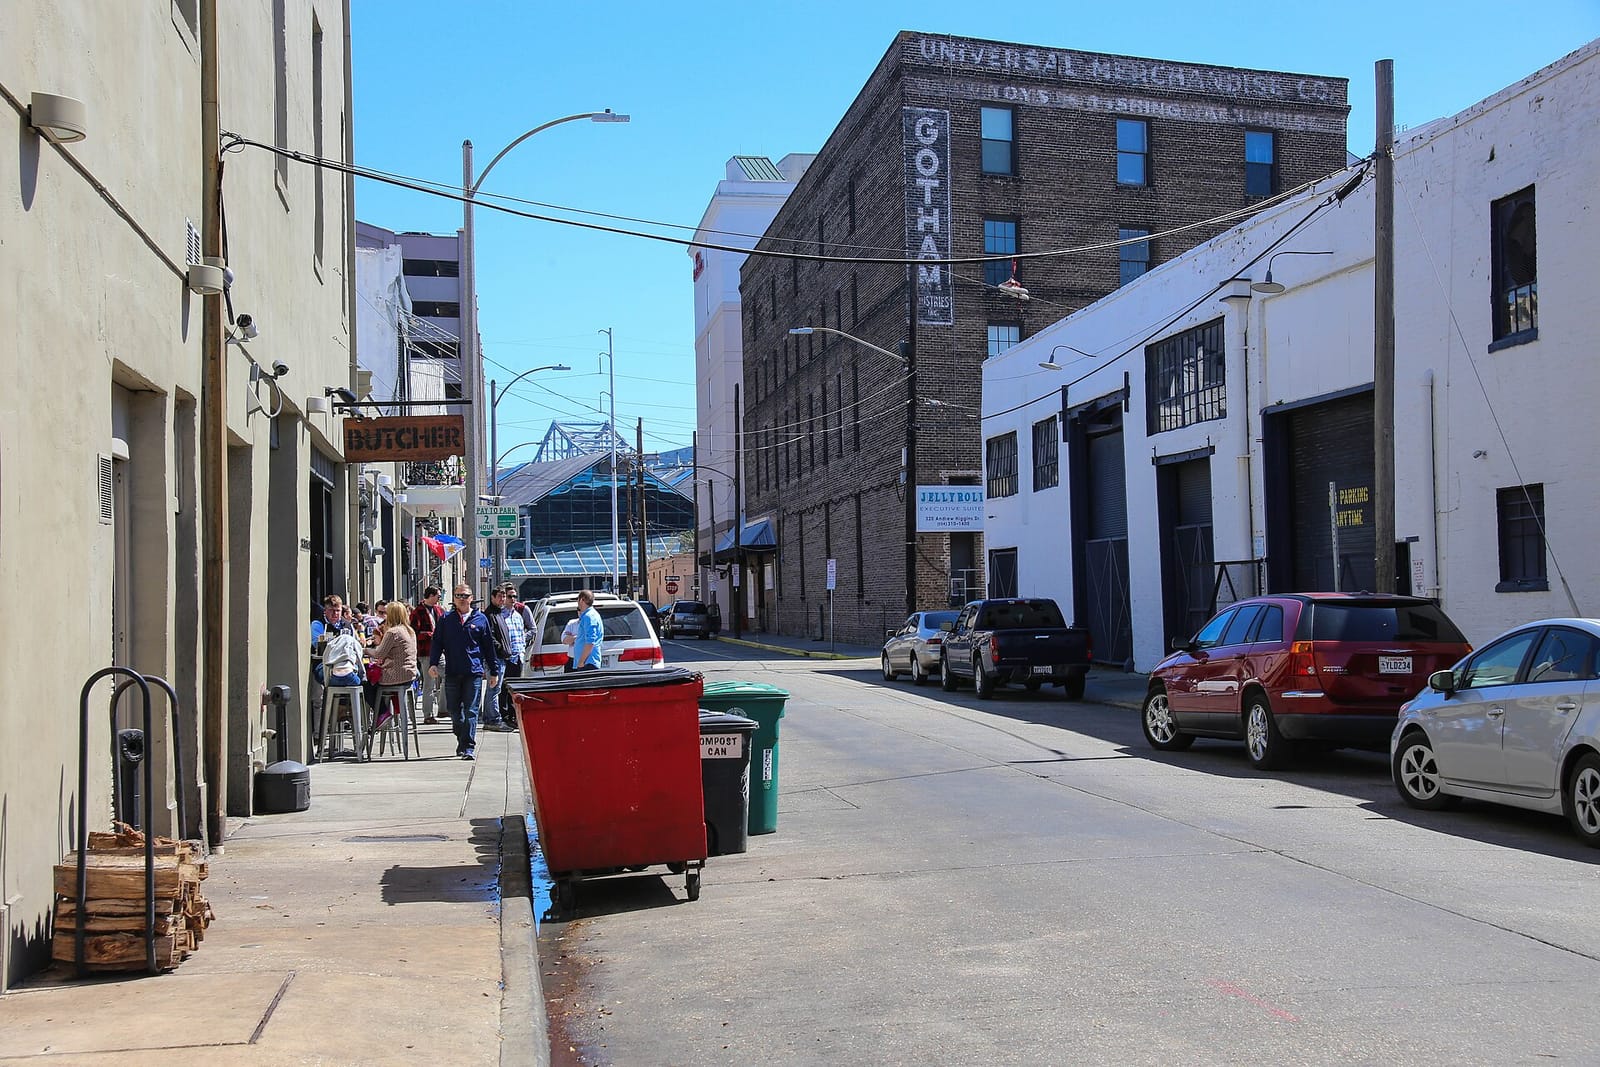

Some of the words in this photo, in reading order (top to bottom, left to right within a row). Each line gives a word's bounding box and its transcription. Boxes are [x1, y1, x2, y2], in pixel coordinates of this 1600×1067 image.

[920, 38, 1077, 78] UNIVERSAL
[1092, 58, 1284, 98] MERCHANDISE
[914, 117, 941, 284] GOTHAM
[347, 425, 461, 450] BUTCHER
[1339, 487, 1369, 505] PARKING
[484, 515, 490, 524] 2
[700, 736, 737, 746] OMPOST
[707, 747, 727, 756] CAN
